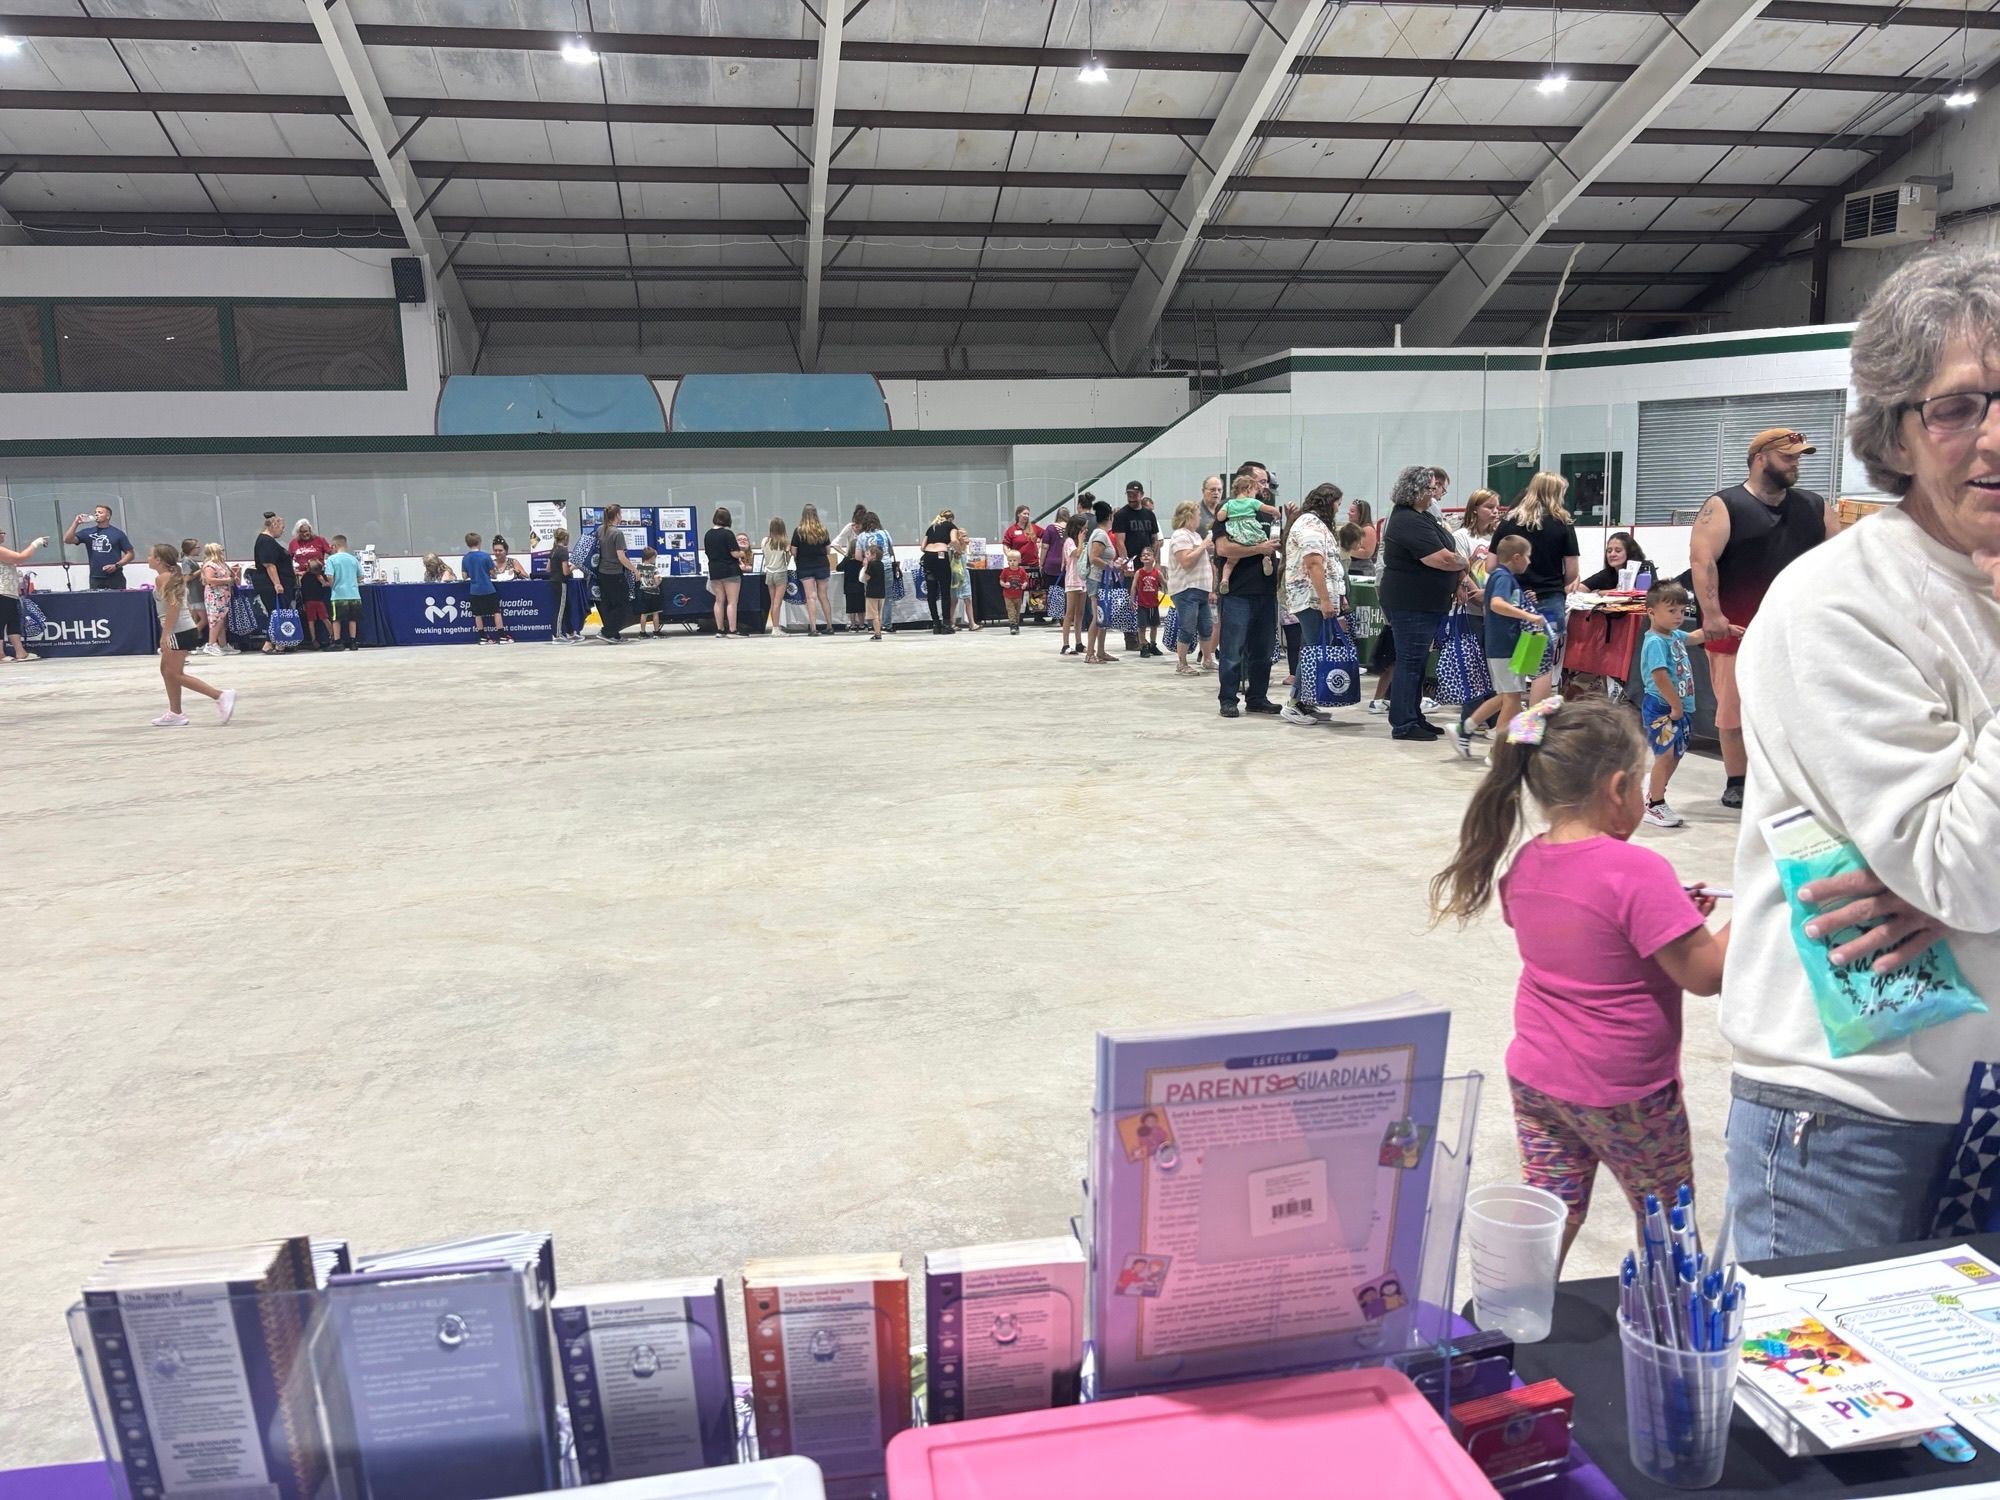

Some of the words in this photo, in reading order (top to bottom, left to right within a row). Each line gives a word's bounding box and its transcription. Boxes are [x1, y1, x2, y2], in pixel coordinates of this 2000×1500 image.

[1130, 519, 1152, 531] DAD
[500, 598, 533, 608] ucation
[503, 608, 539, 616] Services
[20, 619, 112, 640] DHHS
[414, 627, 442, 635] Working
[443, 626, 470, 635] together
[510, 624, 552, 632] achievement
[1166, 1074, 1280, 1103] PARENTS
[1295, 1064, 1392, 1091] GUARDIANS
[1826, 1390, 1914, 1420] Child
